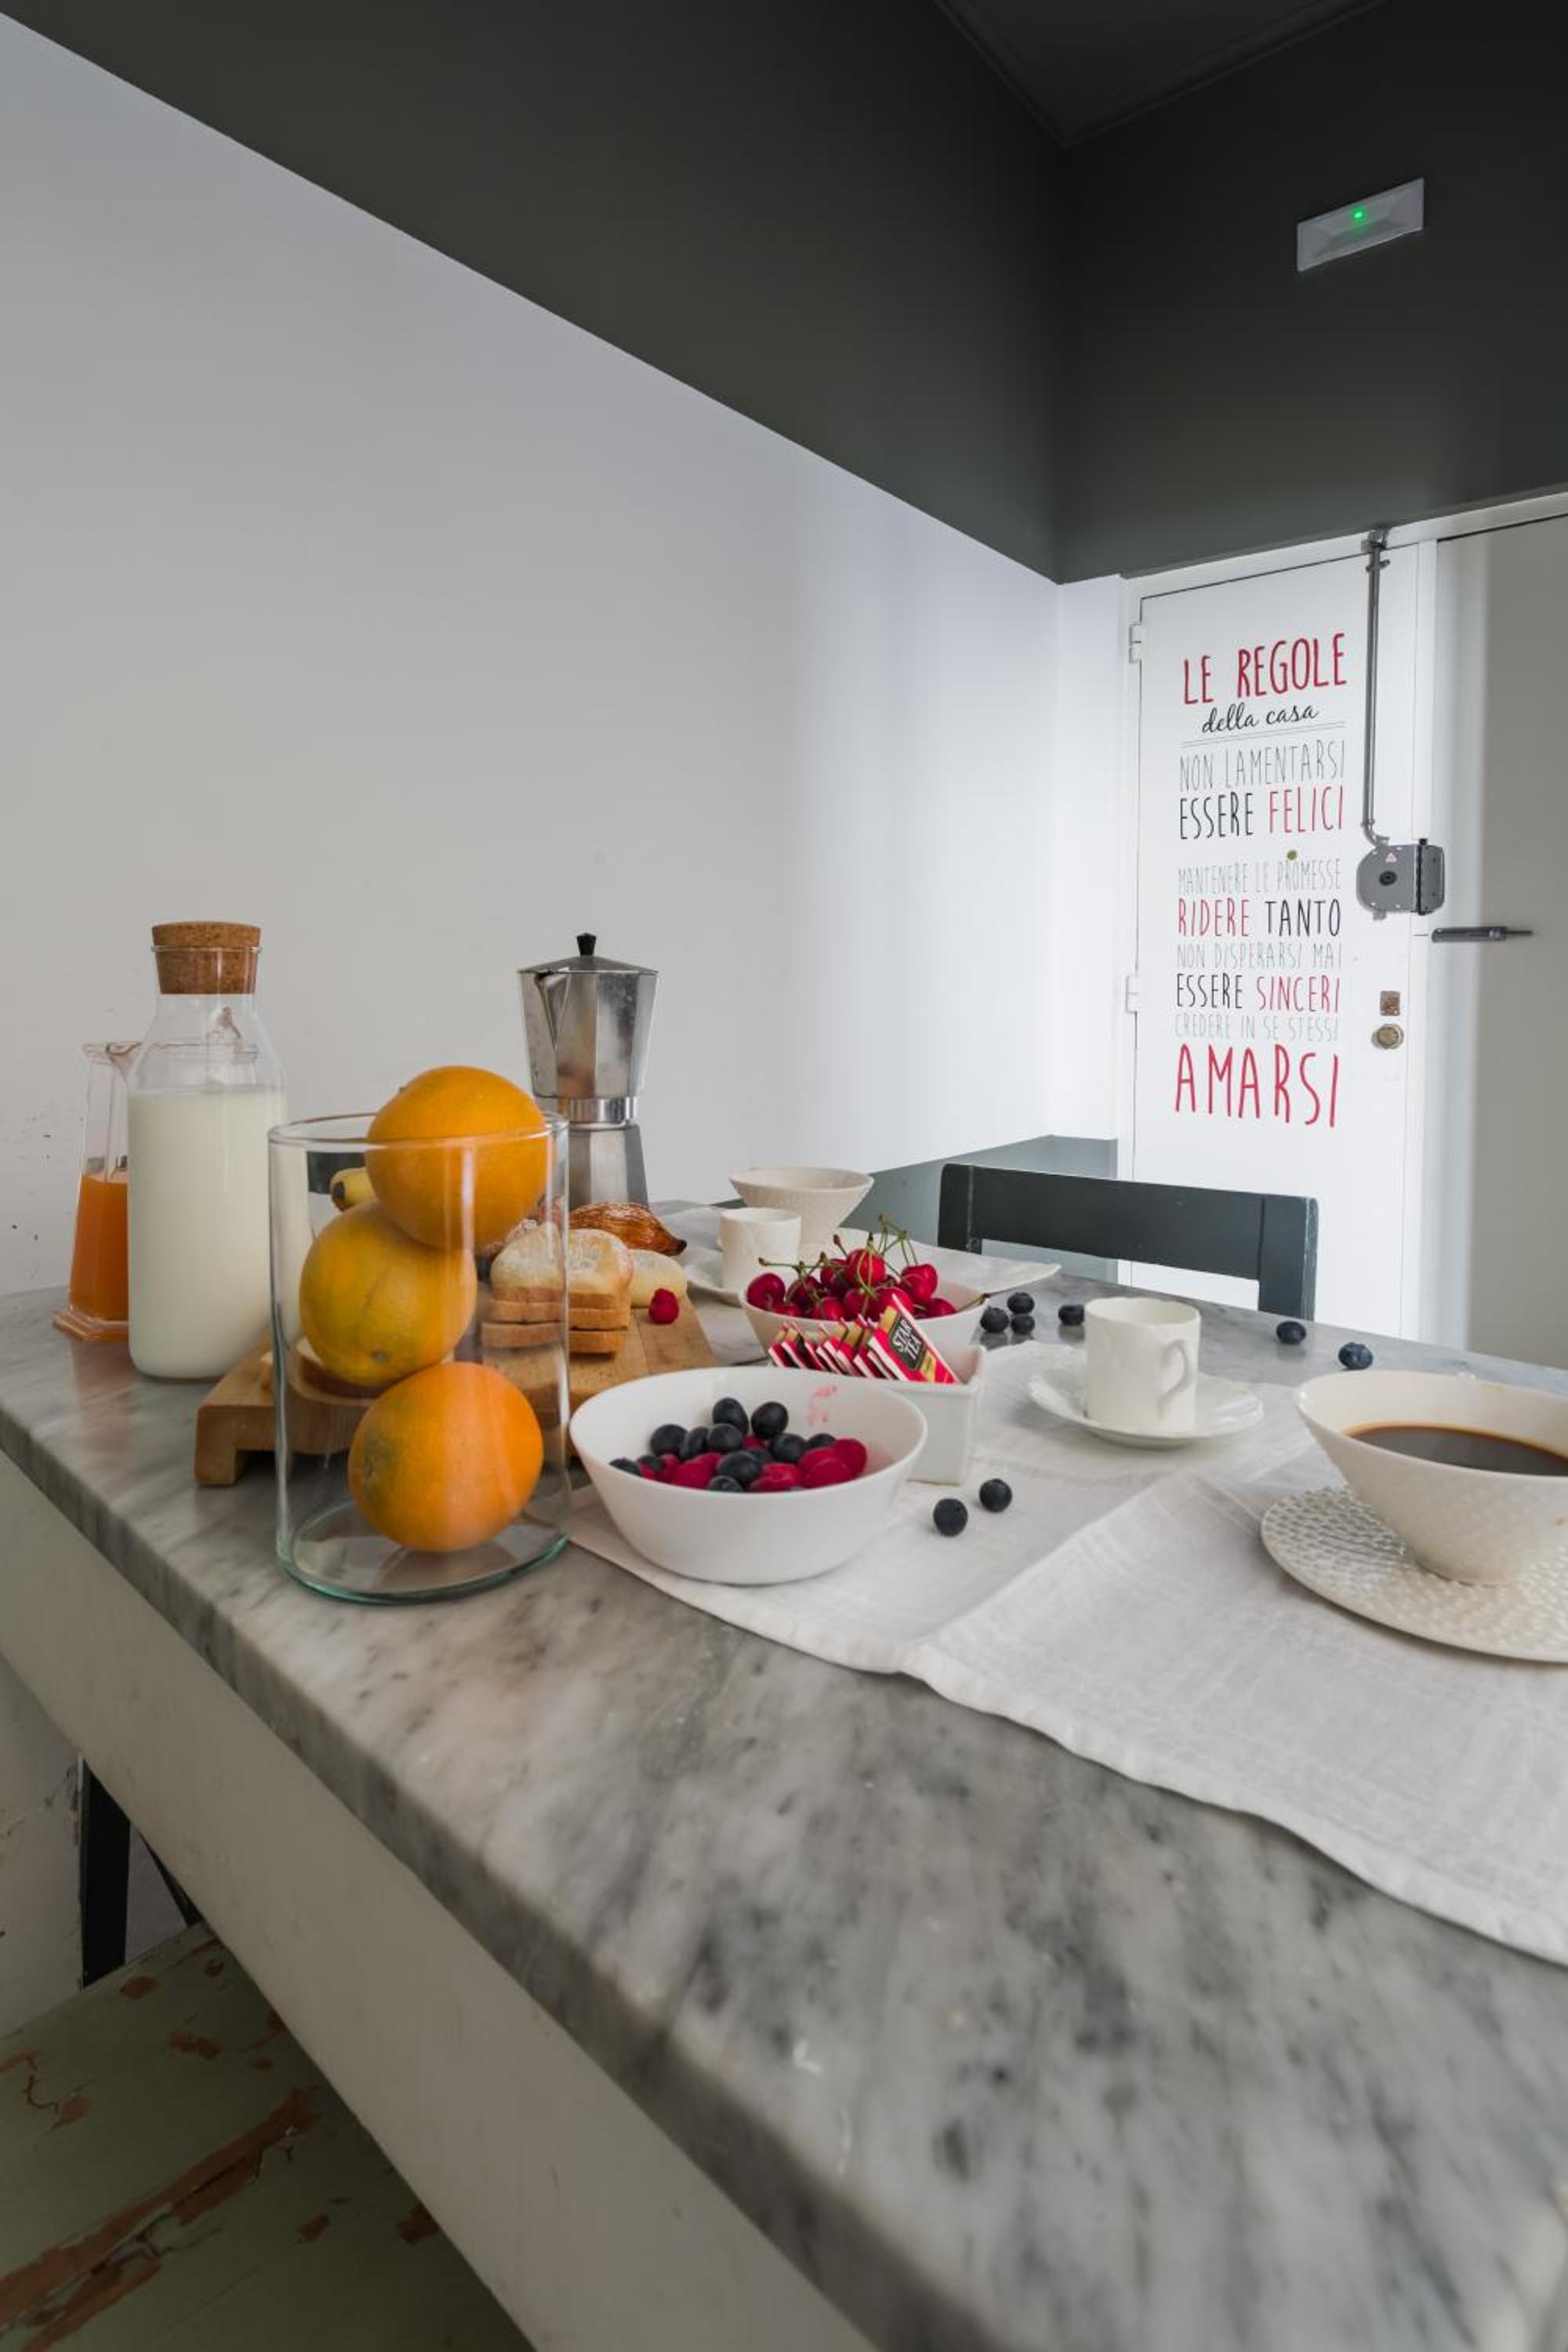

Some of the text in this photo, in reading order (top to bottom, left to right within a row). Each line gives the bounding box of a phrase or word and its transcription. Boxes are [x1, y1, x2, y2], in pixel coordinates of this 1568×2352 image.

[1183, 632, 1348, 705] LE REGOLE
[1202, 702, 1320, 734] della casa
[1180, 739, 1345, 792] NON LAMENTARSI
[1180, 785, 1344, 840] ESSERE FELICI
[1178, 858, 1342, 895] MANTENERE LE PROMESSE
[1178, 897, 1342, 938] RIDERE TANTO
[1177, 942, 1342, 969] NON DISPERARSI MAI
[1177, 972, 1340, 1014] ESSERE SINCERI
[1175, 1013, 1230, 1039] CREDERE
[1242, 1015, 1255, 1040] IN
[1288, 1016, 1338, 1042] STESSI
[1175, 1043, 1339, 1128] AMARSI
[892, 1319, 913, 1352] STAR
[903, 1334, 924, 1360] TEA
